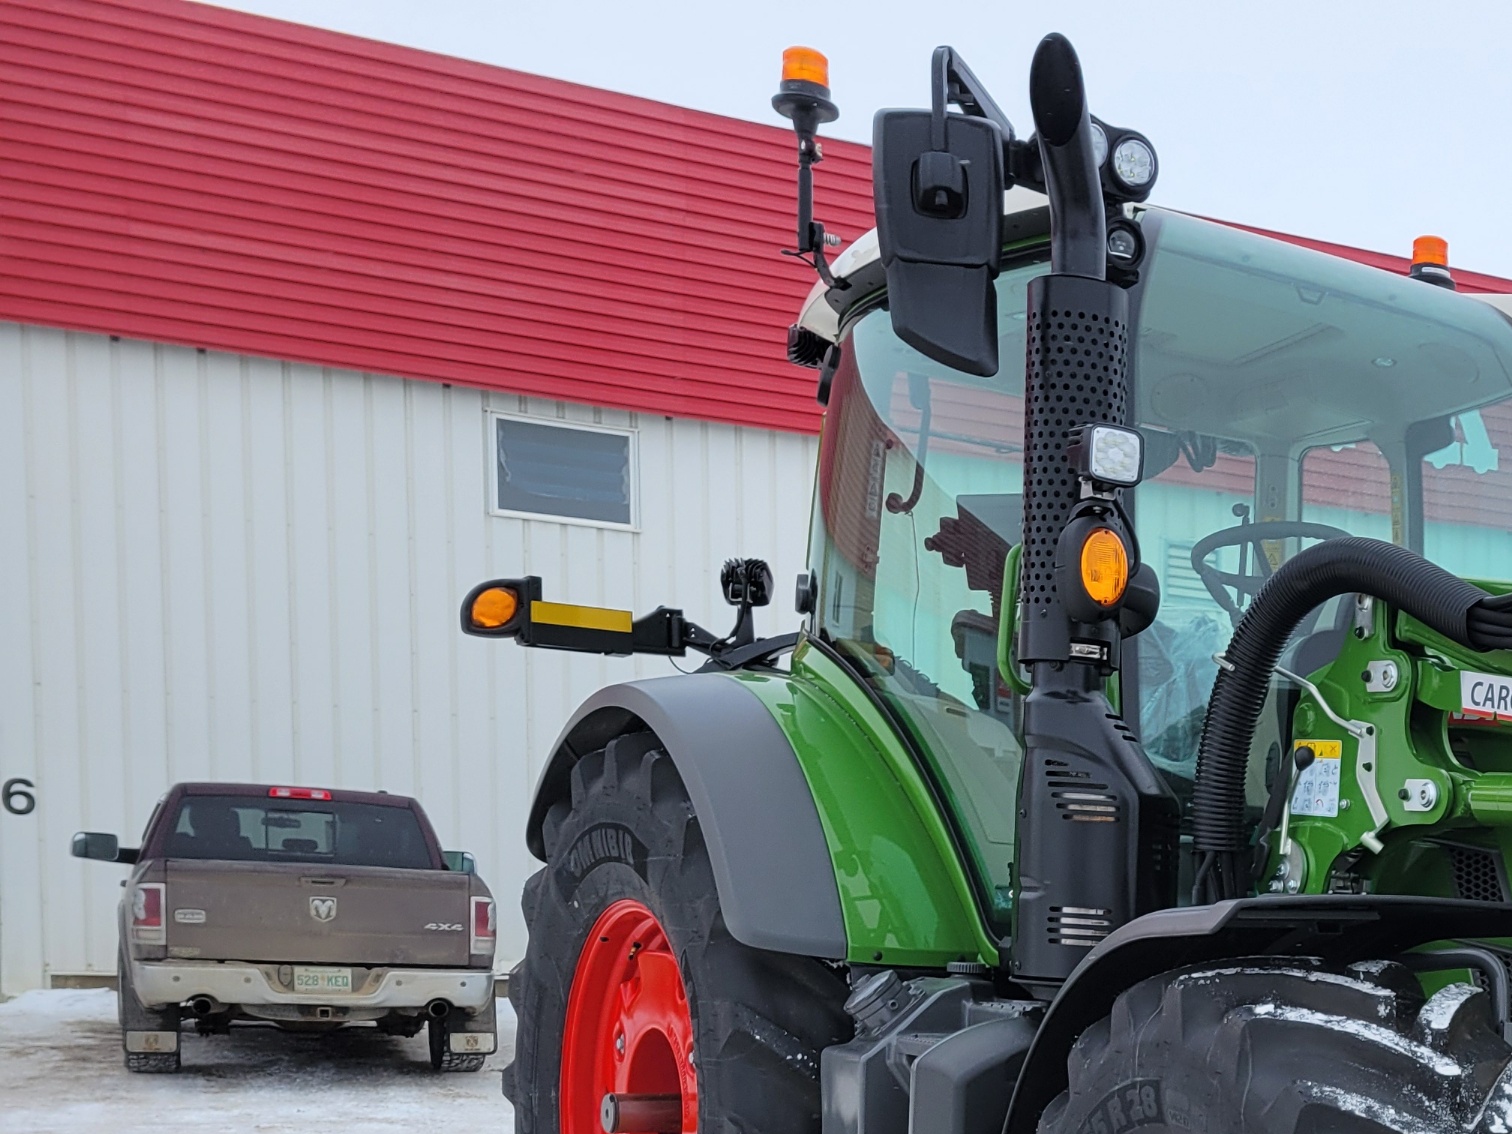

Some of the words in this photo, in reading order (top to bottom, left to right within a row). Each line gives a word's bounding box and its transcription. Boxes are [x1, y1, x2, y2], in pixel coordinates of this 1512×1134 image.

[1, 777, 36, 815] 6
[570, 828, 635, 878] OMNIBIB
[297, 974, 320, 986] 528
[1125, 1085, 1158, 1122] 28
